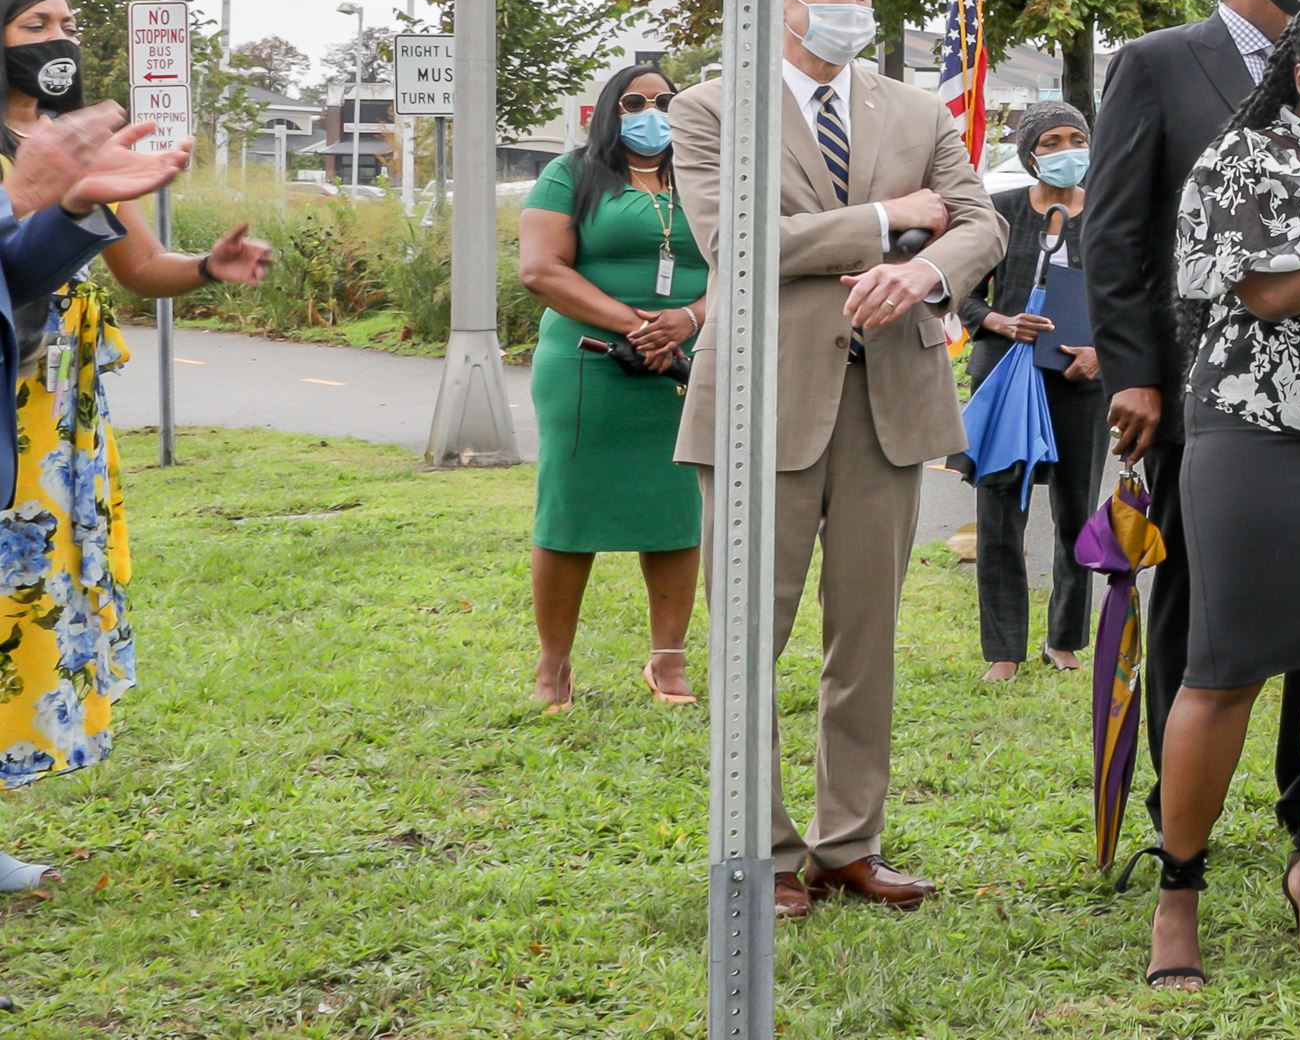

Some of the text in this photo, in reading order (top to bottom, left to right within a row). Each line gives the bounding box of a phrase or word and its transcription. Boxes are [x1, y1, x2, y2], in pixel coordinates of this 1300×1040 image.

[149, 10, 170, 25] NO
[135, 29, 185, 45] STOPPING
[150, 46, 171, 57] BUS
[401, 45, 440, 58] RIGHT
[146, 59, 174, 70] STOP
[150, 93, 171, 109] NO
[401, 92, 455, 105] TURN R
[137, 112, 186, 122] STOPPING
